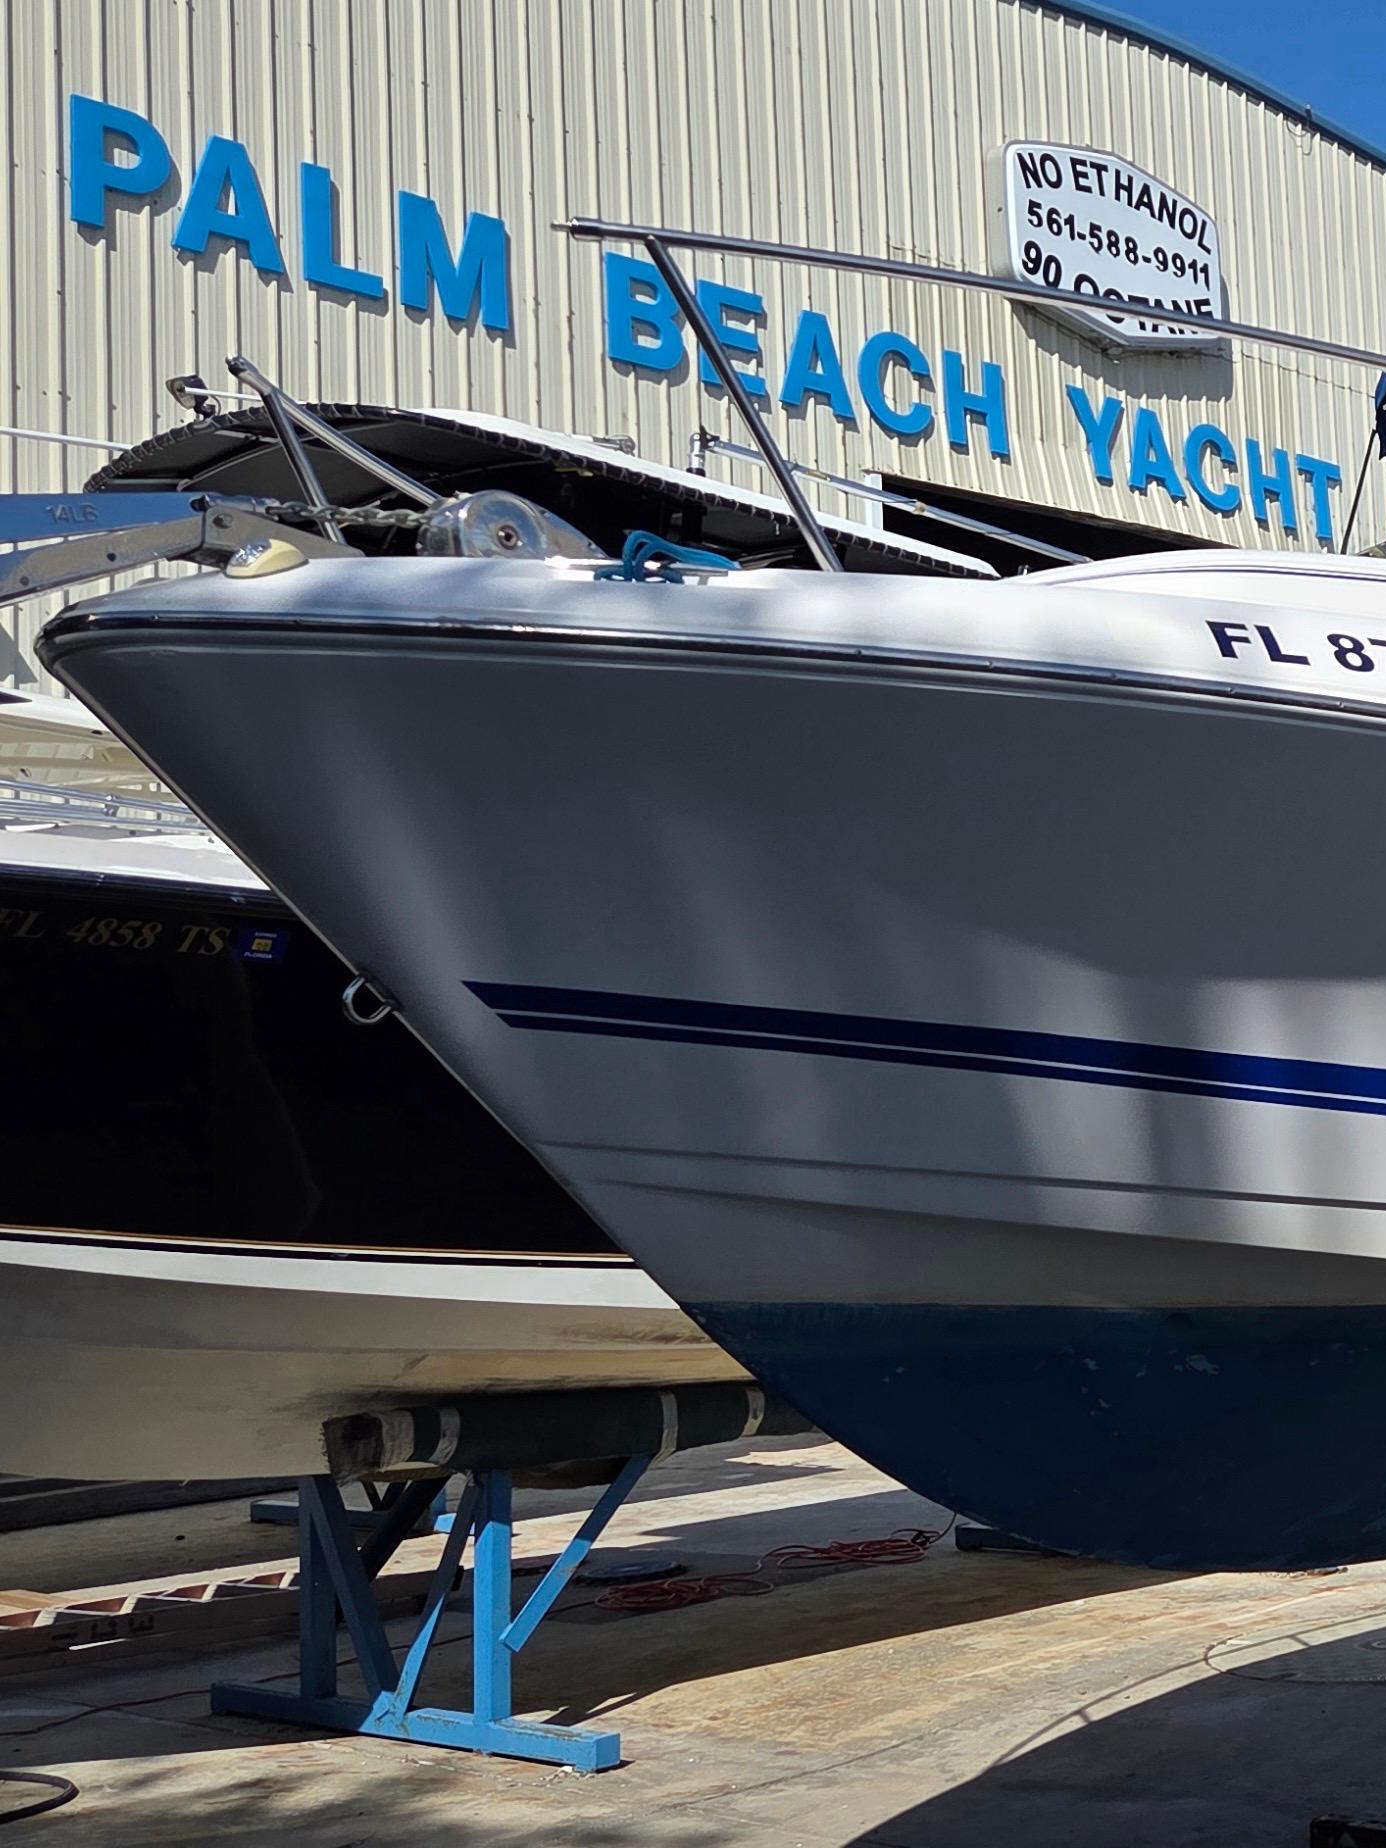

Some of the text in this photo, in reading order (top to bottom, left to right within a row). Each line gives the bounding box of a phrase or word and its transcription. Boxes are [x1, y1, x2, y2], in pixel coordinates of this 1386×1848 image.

[1017, 152, 1212, 255] NO ETHANOL
[1022, 240, 1062, 288] 90
[1027, 199, 1210, 291] 561-588-9911
[69, 93, 509, 330] PALM
[604, 252, 1010, 456] BEACH
[1065, 384, 1341, 541] YACHT
[1206, 620, 1311, 666] FL
[0, 908, 232, 955] FL 4858 TS
